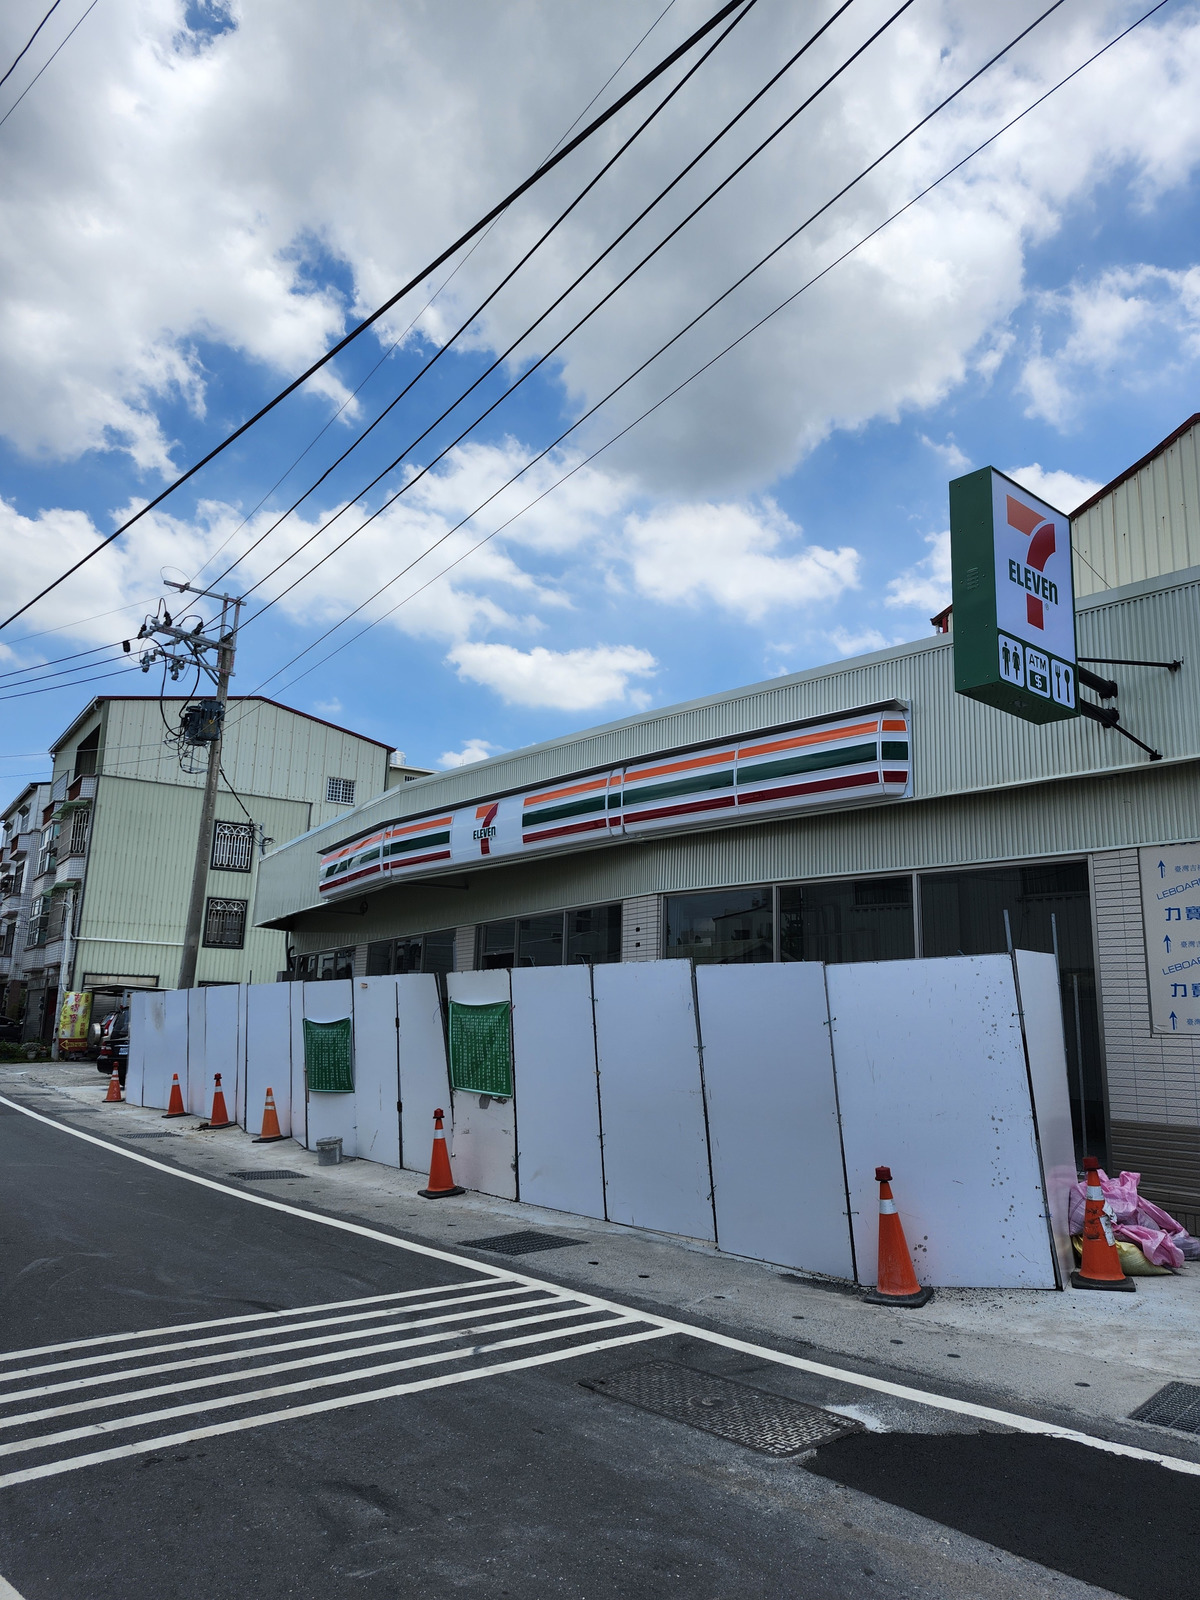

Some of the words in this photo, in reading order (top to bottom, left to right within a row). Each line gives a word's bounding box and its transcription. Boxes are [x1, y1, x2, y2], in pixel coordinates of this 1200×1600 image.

[1006, 494, 1056, 631] 7
[1028, 652, 1047, 672] ATM
[475, 802, 499, 855] 7
[1156, 878, 1200, 900] LEBOAR
